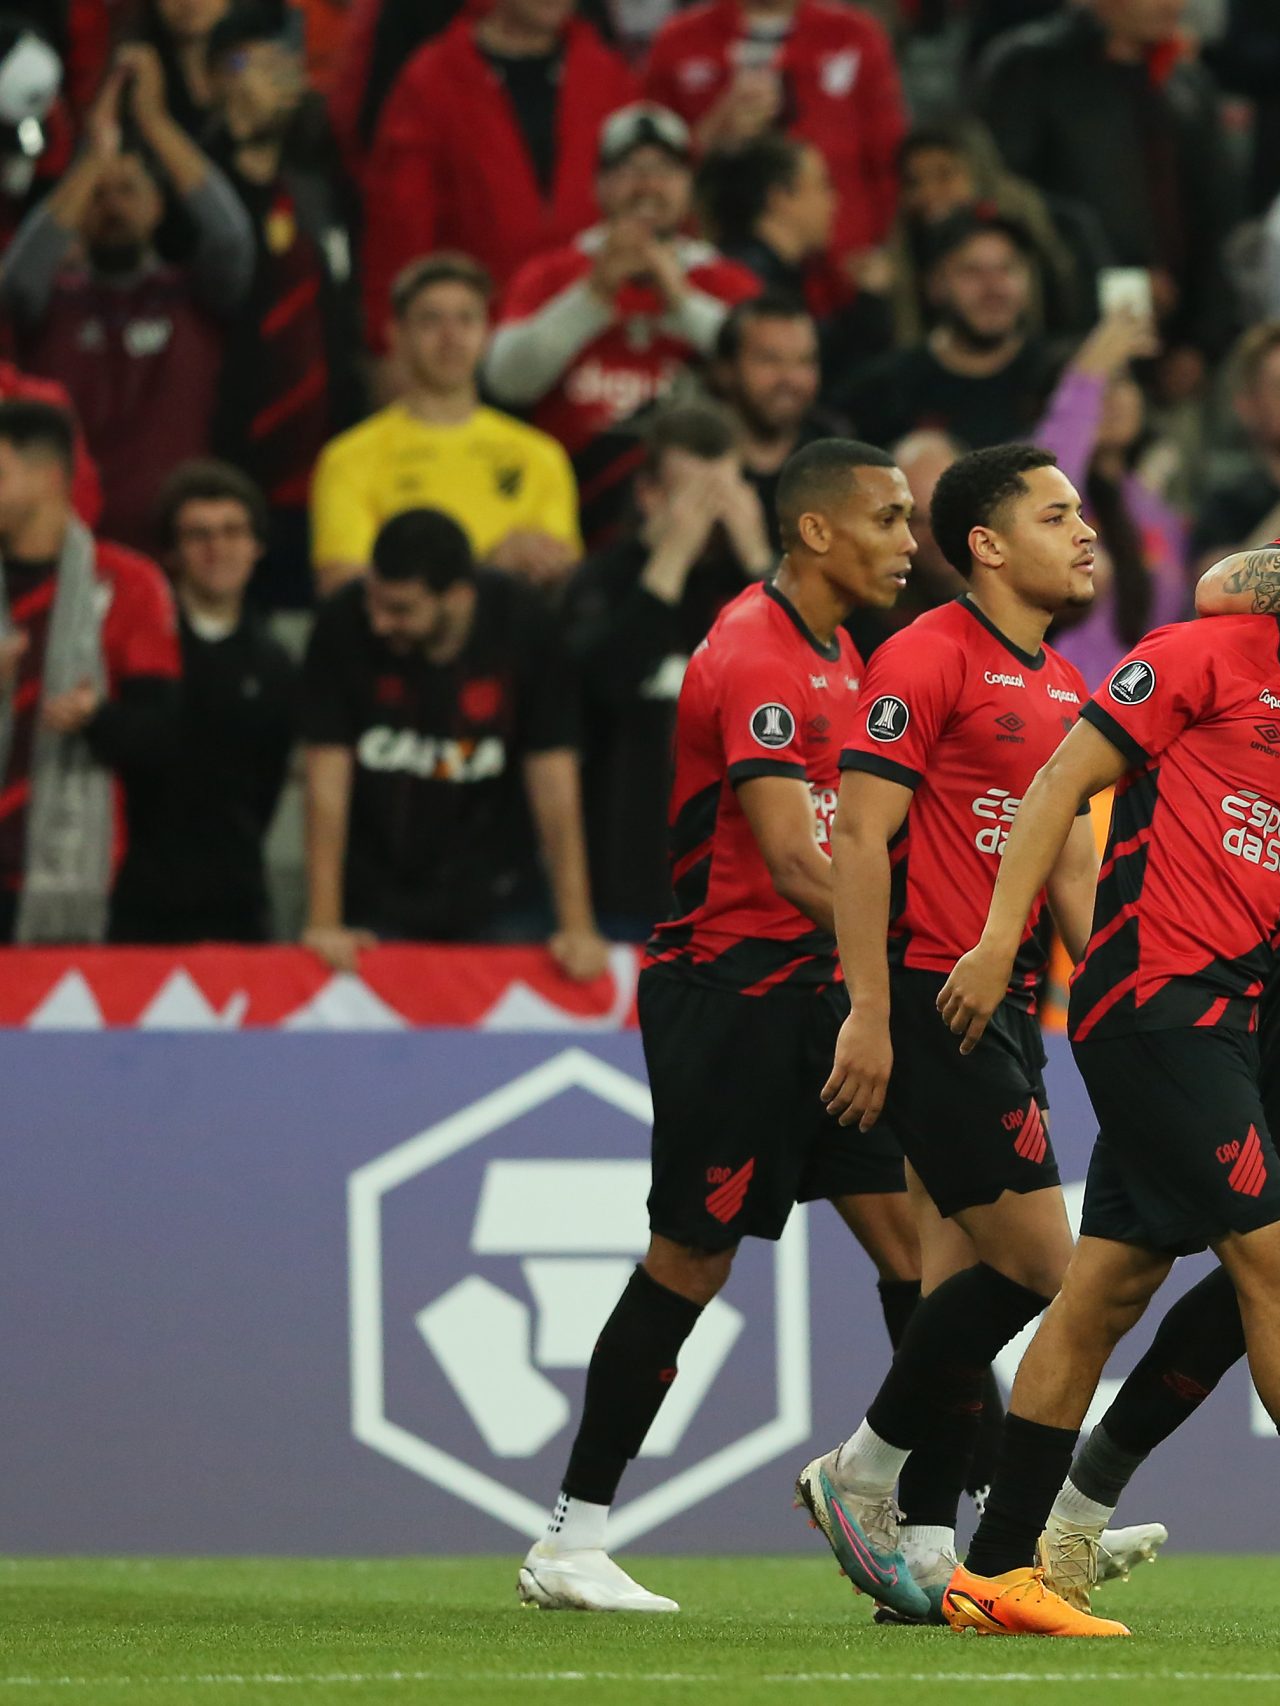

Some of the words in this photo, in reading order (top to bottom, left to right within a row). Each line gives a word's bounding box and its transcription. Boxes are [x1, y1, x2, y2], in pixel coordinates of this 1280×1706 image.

[984, 670, 1026, 689] Copacol
[1250, 740, 1280, 759] umbro
[1001, 1108, 1024, 1131] CAP
[1215, 1139, 1241, 1164] CAP
